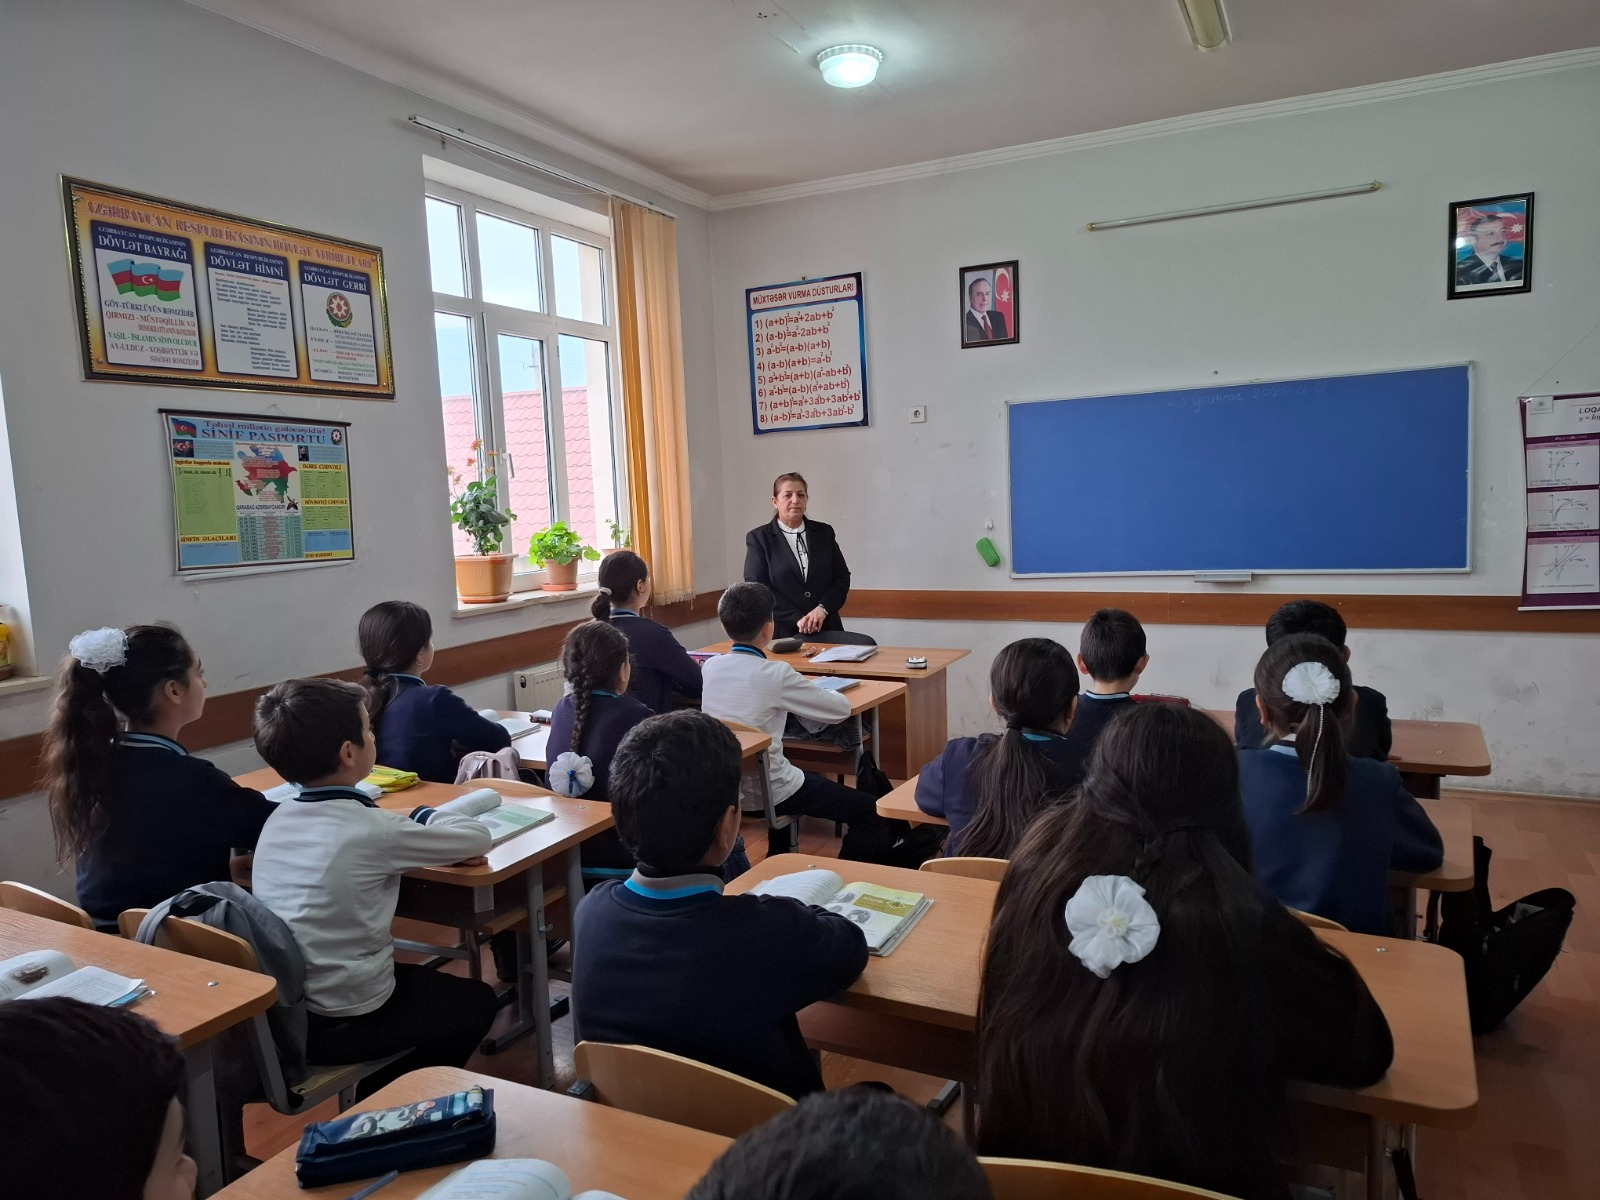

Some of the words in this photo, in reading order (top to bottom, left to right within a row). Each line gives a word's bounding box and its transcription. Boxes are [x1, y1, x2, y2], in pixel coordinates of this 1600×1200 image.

[85, 200, 172, 230] AZƏRBAYCAN
[98, 234, 142, 252] DÖVLƏT
[144, 243, 187, 260] BAYRAĞI
[210, 255, 251, 272] DÖVLƏT
[255, 263, 284, 277] HİMNİ
[304, 272, 340, 287] DÖVLƏT
[342, 279, 367, 292] GERBİ
[752, 292, 787, 305] MÜXTƏSƏR
[788, 290, 811, 300] VURMA
[812, 283, 854, 297] DÜSTURLARI
[755, 319, 763, 330] 1)
[755, 333, 763, 344] 2)
[756, 347, 764, 357] 3)
[757, 361, 765, 372] 4)
[757, 375, 766, 386] 5)
[758, 388, 767, 398] 6)
[759, 401, 768, 412] 7)
[760, 414, 768, 424] 8)
[204, 420, 235, 429] Təhsil
[237, 422, 272, 432] millətin
[275, 425, 325, 435] gələcəyidir!
[201, 427, 244, 439] SİNİF
[248, 431, 325, 444] PASPORTU
